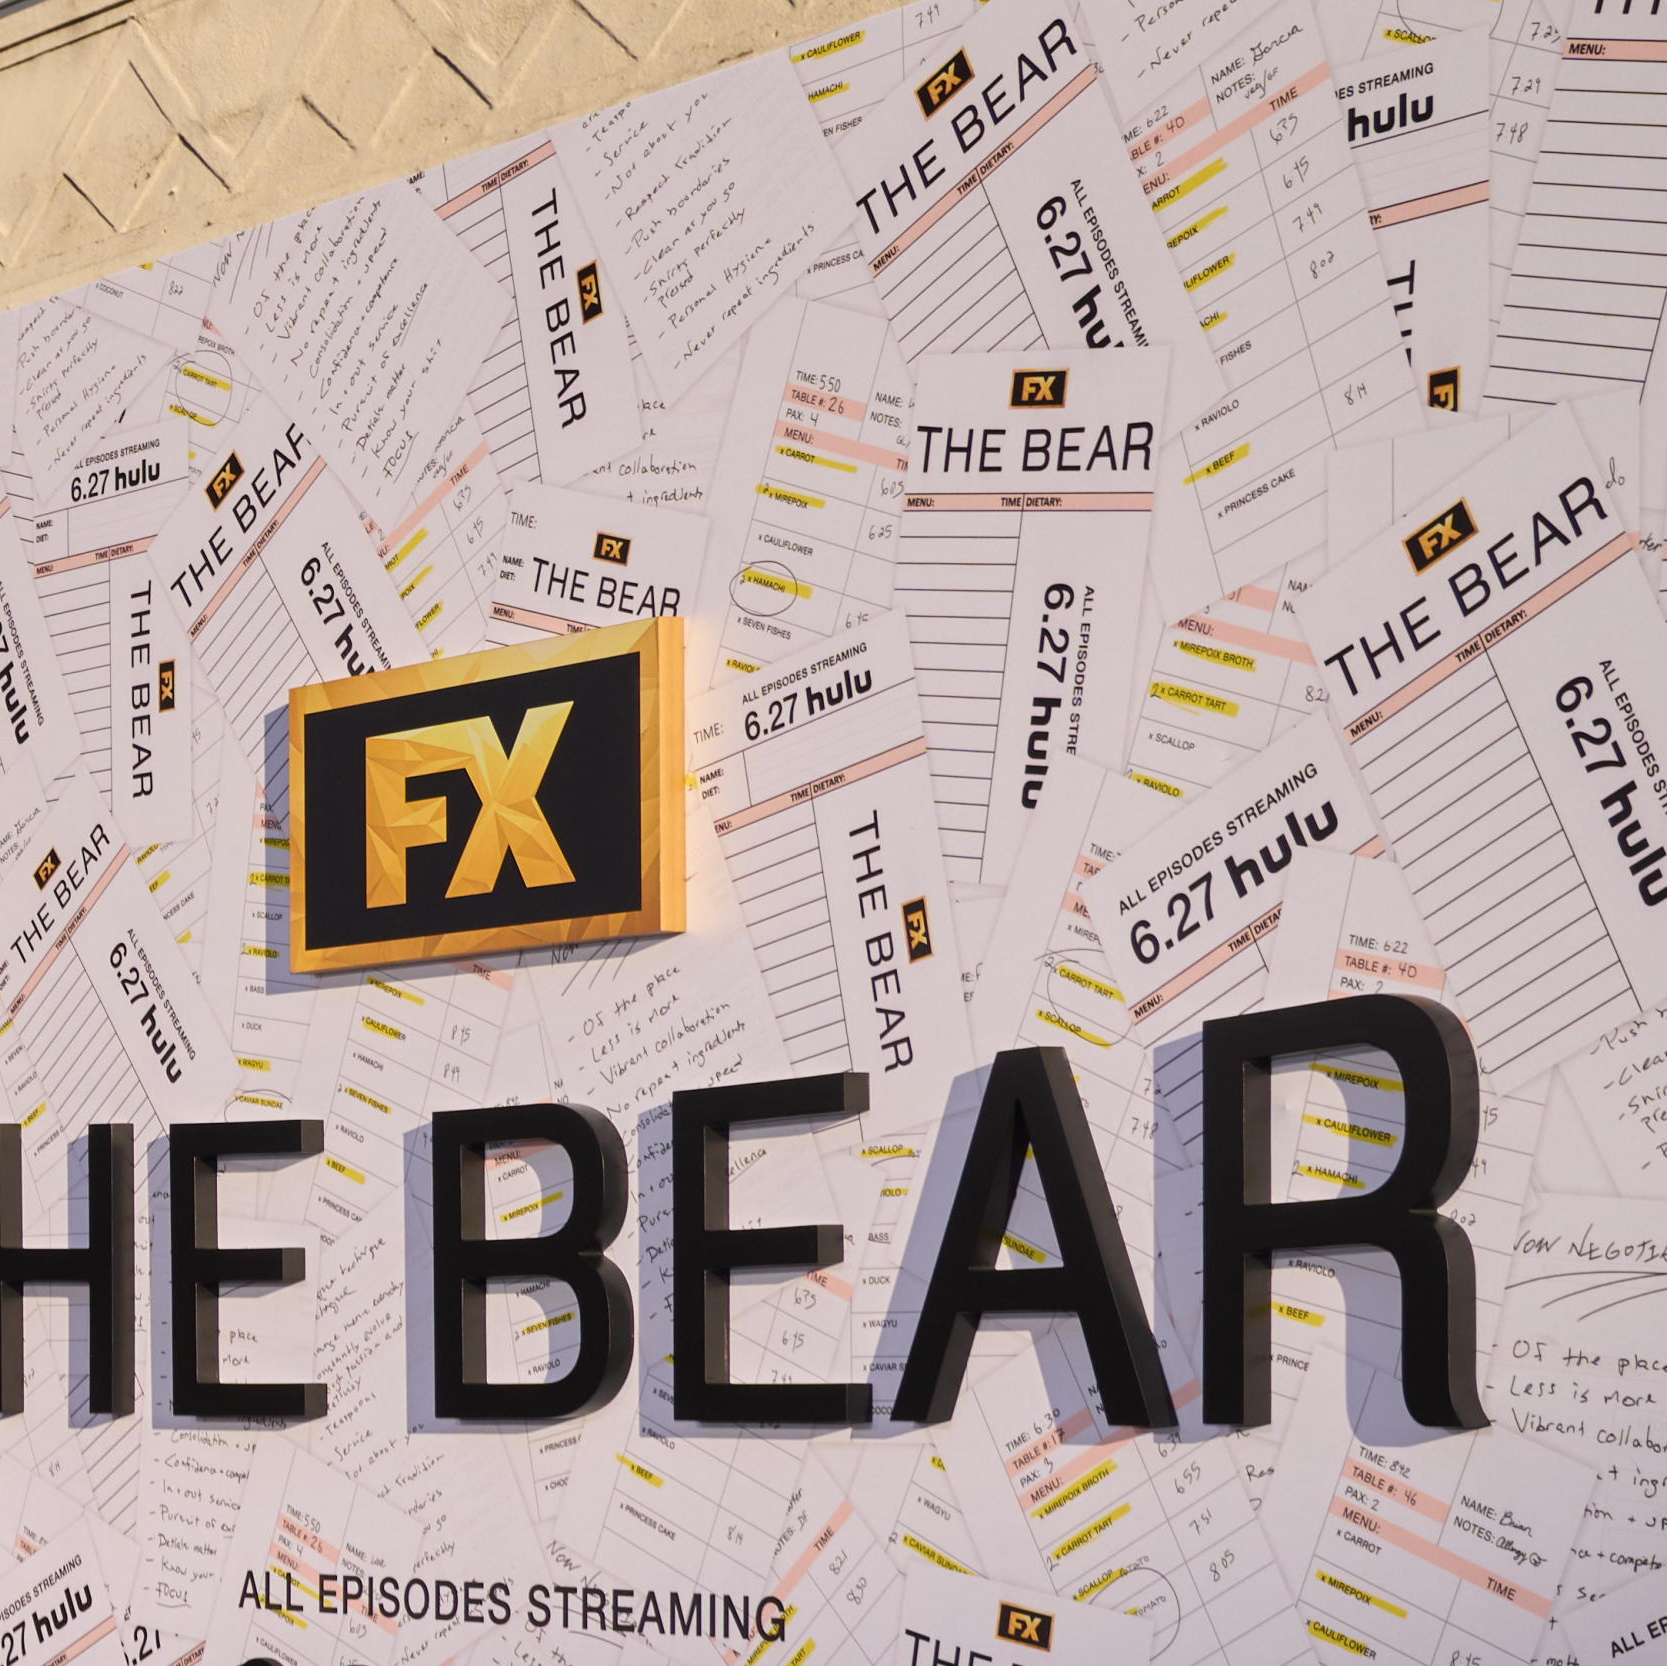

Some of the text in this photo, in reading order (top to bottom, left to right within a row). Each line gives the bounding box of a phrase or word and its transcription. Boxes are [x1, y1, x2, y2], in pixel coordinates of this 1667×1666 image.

[685, 92, 707, 123] you
[855, 18, 1078, 235] THE BEAR
[603, 121, 648, 166] Service
[956, 141, 1015, 196] TIME DIETARY:
[632, 219, 662, 247] Push
[643, 237, 680, 276] Clean
[1035, 195, 1093, 282] 6.27
[1071, 179, 1118, 281] ALL EPISODES
[872, 243, 901, 273] MENU:
[529, 187, 588, 430] THE BEAR
[668, 283, 718, 329] Personal
[796, 371, 818, 384] TIME:
[119, 438, 161, 463] STREAMING
[916, 421, 1154, 473] THE BEAR
[70, 458, 161, 501] 6.27 hulu
[170, 534, 234, 608] THE
[763, 535, 813, 556] CAULIFLOWER
[299, 557, 347, 627] 6.27
[532, 557, 682, 619] THE BEAR
[1324, 476, 1609, 697] THE BEAR
[742, 616, 766, 633] SEVEN
[1484, 609, 1529, 643] DIETARY:
[130, 580, 154, 799] THE BEAR
[742, 642, 867, 704] ALL EPISODES STREAMING
[1071, 623, 1092, 707] EPISODES
[744, 667, 873, 741] 6.27 hulu
[1021, 582, 1075, 809] 6.27 hulu
[1555, 675, 1626, 773] 6.27
[365, 700, 577, 909] FX
[849, 809, 913, 1073] THE BEAR
[430, 995, 1492, 1432] BEAR
[1563, 1348, 1601, 1367] the
[1510, 1375, 1556, 1396] Less
[1572, 1383, 1589, 1403] is
[1512, 1408, 1584, 1436] Vibrant
[1359, 1447, 1388, 1468] TIME:
[1461, 1495, 1497, 1521] NAME:
[1343, 1531, 1382, 1555] CARROT
[33, 1582, 93, 1643] hulu
[238, 1570, 788, 1643] ALL EPISODES STREAMING
[1328, 1577, 1371, 1605] MIREPOIX
